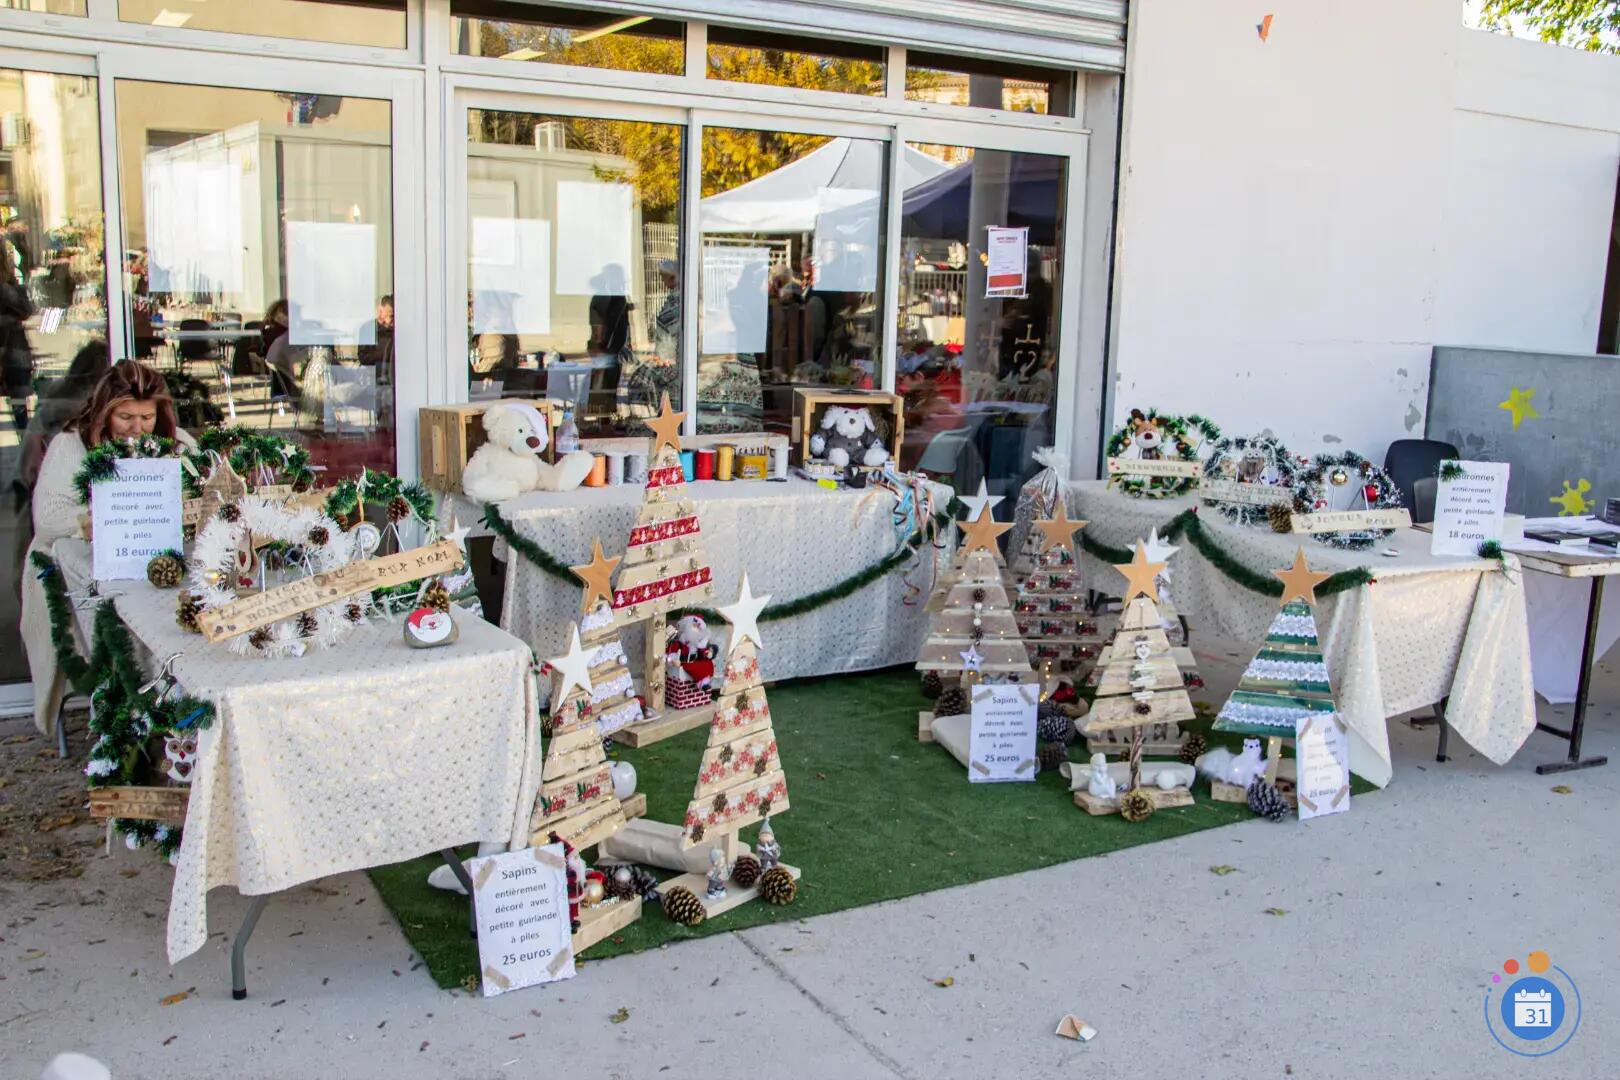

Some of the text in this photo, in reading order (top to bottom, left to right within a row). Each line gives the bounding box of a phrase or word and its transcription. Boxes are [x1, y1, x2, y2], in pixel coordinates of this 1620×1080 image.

[110, 472, 165, 483] ouronnes
[104, 516, 171, 526] petite guirlande
[133, 531, 152, 540] piles
[1448, 530, 1485, 540] 18 euros
[115, 547, 128, 557] 18
[992, 696, 1018, 705] Sapins
[984, 754, 1020, 762] 25 euros
[501, 865, 537, 880] Sapins
[495, 882, 547, 899] entièrement
[495, 898, 550, 914] décoré avec
[489, 912, 558, 933] petite guirlande
[520, 931, 540, 944] piles
[502, 947, 552, 966] 25 euros
